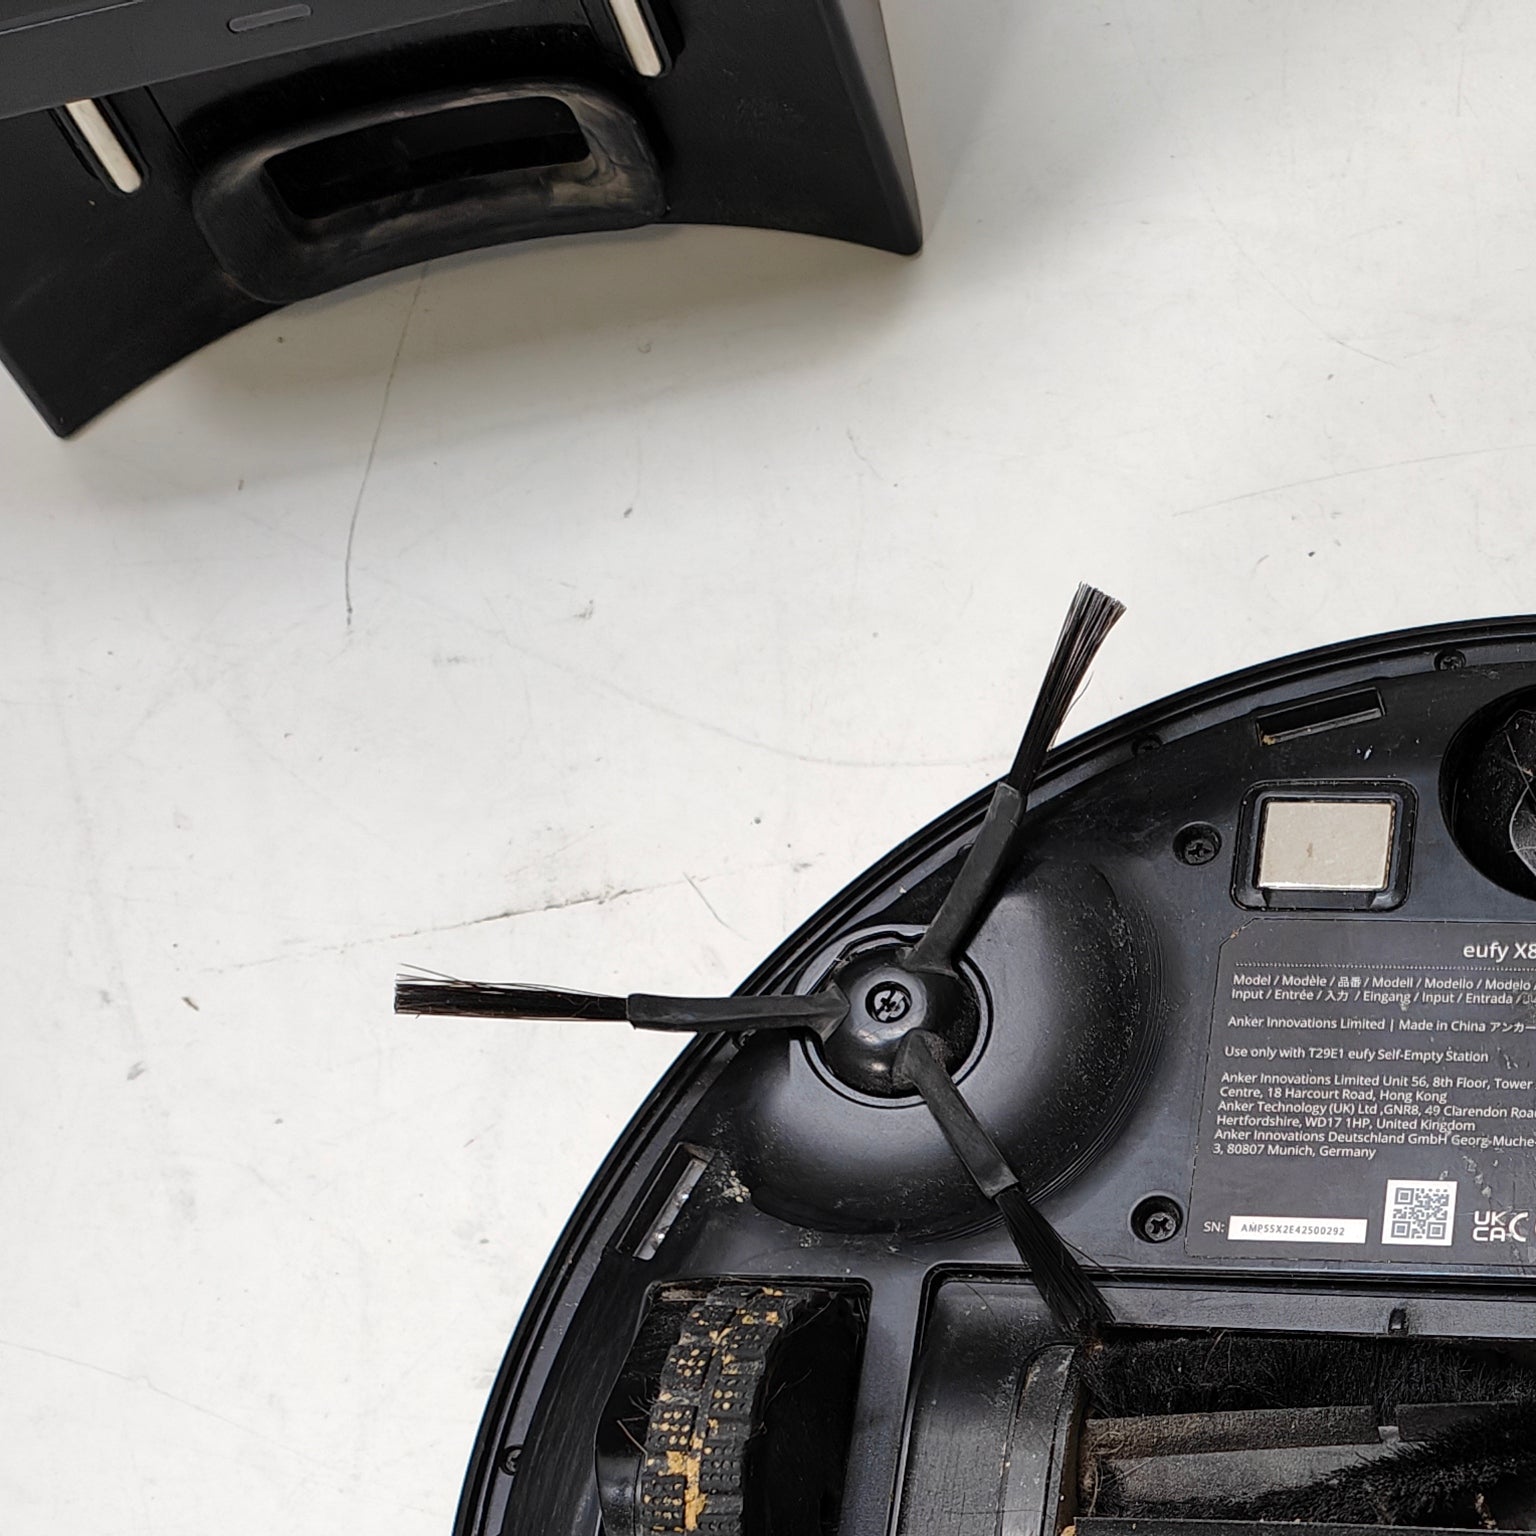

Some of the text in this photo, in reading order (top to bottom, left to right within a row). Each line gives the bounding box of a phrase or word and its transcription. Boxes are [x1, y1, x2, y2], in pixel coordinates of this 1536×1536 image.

[1463, 942, 1508, 963] eufy
[1233, 974, 1272, 986] Model
[1282, 975, 1327, 988] Modèle
[1338, 976, 1362, 988] 品番
[1372, 977, 1413, 988] Modell
[1424, 978, 1474, 990] Modello
[1486, 979, 1531, 990] Modelo
[1232, 989, 1264, 1001] Input
[1274, 990, 1314, 1000] Entrée
[1325, 991, 1349, 1002] 入力
[1364, 992, 1410, 1004] Eingang
[1422, 992, 1455, 1004] Input
[1466, 993, 1512, 1004] Entrada
[1228, 1016, 1264, 1028] Anker
[1267, 1017, 1337, 1029] Innovations
[1340, 1018, 1385, 1030] Limited
[1399, 1019, 1433, 1031] Made
[1436, 1020, 1448, 1031] in
[1452, 1020, 1486, 1032] China
[1225, 1046, 1488, 1064] Use only with T29E1 eufy Self-Empty Station
[1221, 1072, 1257, 1084] Anker
[1260, 1072, 1331, 1085] Innovations
[1334, 1074, 1380, 1086] Limited
[1383, 1076, 1408, 1087] Unit
[1412, 1076, 1429, 1089] 56,
[1432, 1076, 1453, 1088] 8th
[1456, 1077, 1490, 1090] Floor,
[1494, 1078, 1532, 1090] Tower
[1220, 1086, 1447, 1104] Centre, 18 Harcourt Road, Hong Kong
[1218, 1100, 1254, 1112] Anker
[1258, 1102, 1326, 1115] Technology
[1329, 1103, 1354, 1116] (UK)
[1358, 1104, 1378, 1114] Ltd
[1424, 1106, 1440, 1116] 49
[1444, 1106, 1508, 1118] Clarendon
[1216, 1115, 1476, 1133] Hertfordshire, WD17 1HP, United Kingdom
[1214, 1129, 1252, 1141] Anker
[1254, 1130, 1325, 1142] Innovations
[1328, 1131, 1405, 1144] Deutschland
[1408, 1134, 1448, 1144] GmbH
[1213, 1143, 1376, 1160] 3, 80807 Munich, Germany
[1474, 1210, 1507, 1226] UK
[1203, 1222, 1226, 1233] SN:
[1472, 1226, 1506, 1242] CA
